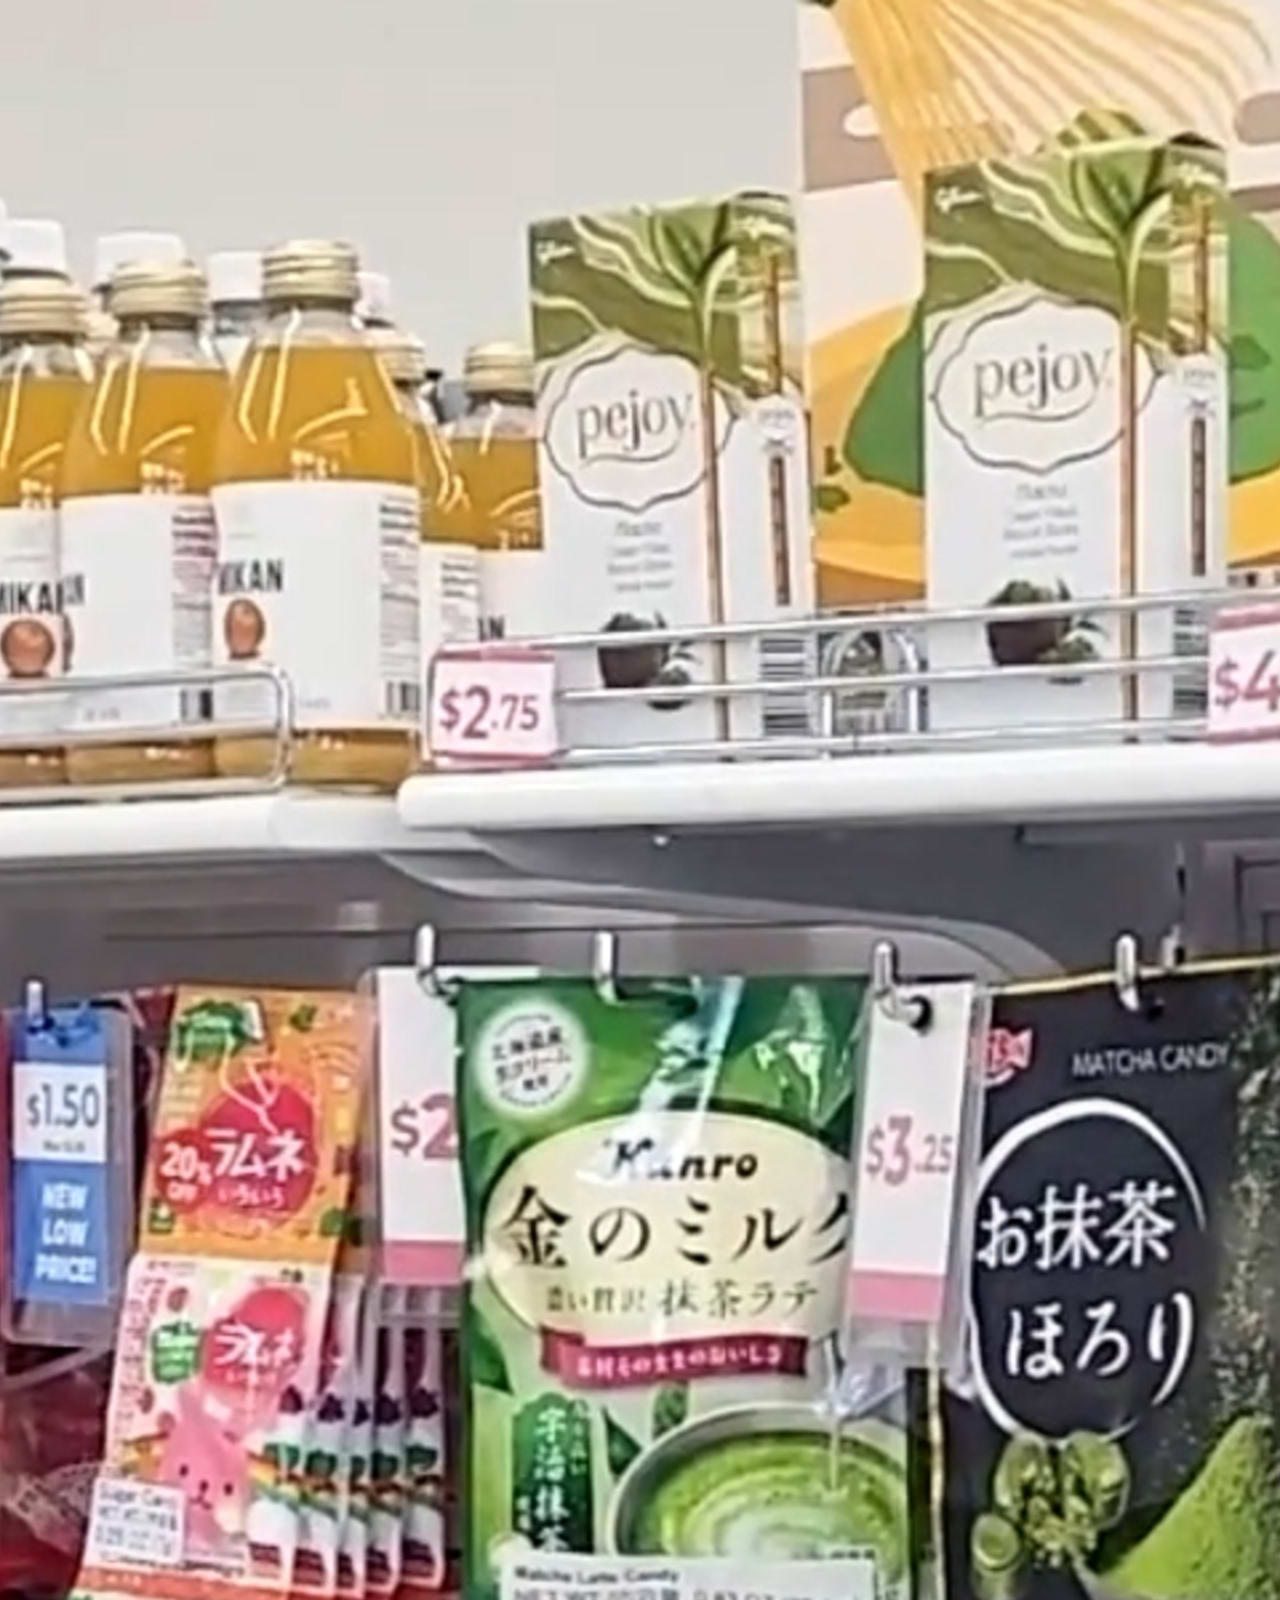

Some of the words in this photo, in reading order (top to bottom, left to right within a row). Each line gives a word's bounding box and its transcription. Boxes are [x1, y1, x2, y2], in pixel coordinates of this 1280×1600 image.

[974, 341, 1112, 420] pejoy
[439, 684, 541, 737] $2.75
[1072, 1047, 1156, 1078] MATCHA
[1160, 1042, 1229, 1073] CANDY
[28, 1085, 101, 1130] $1.50
[211, 1127, 305, 1183] ラムネ
[867, 1117, 953, 1185] $3.25
[41, 1183, 88, 1209] NEW
[41, 1219, 88, 1247] LOW
[501, 1185, 849, 1267] 金のミルク
[976, 1182, 1177, 1269] お抹茶
[35, 1255, 96, 1284] PRICE!
[213, 1321, 294, 1369] ラムネ
[1007, 1292, 1192, 1378] ほろり
